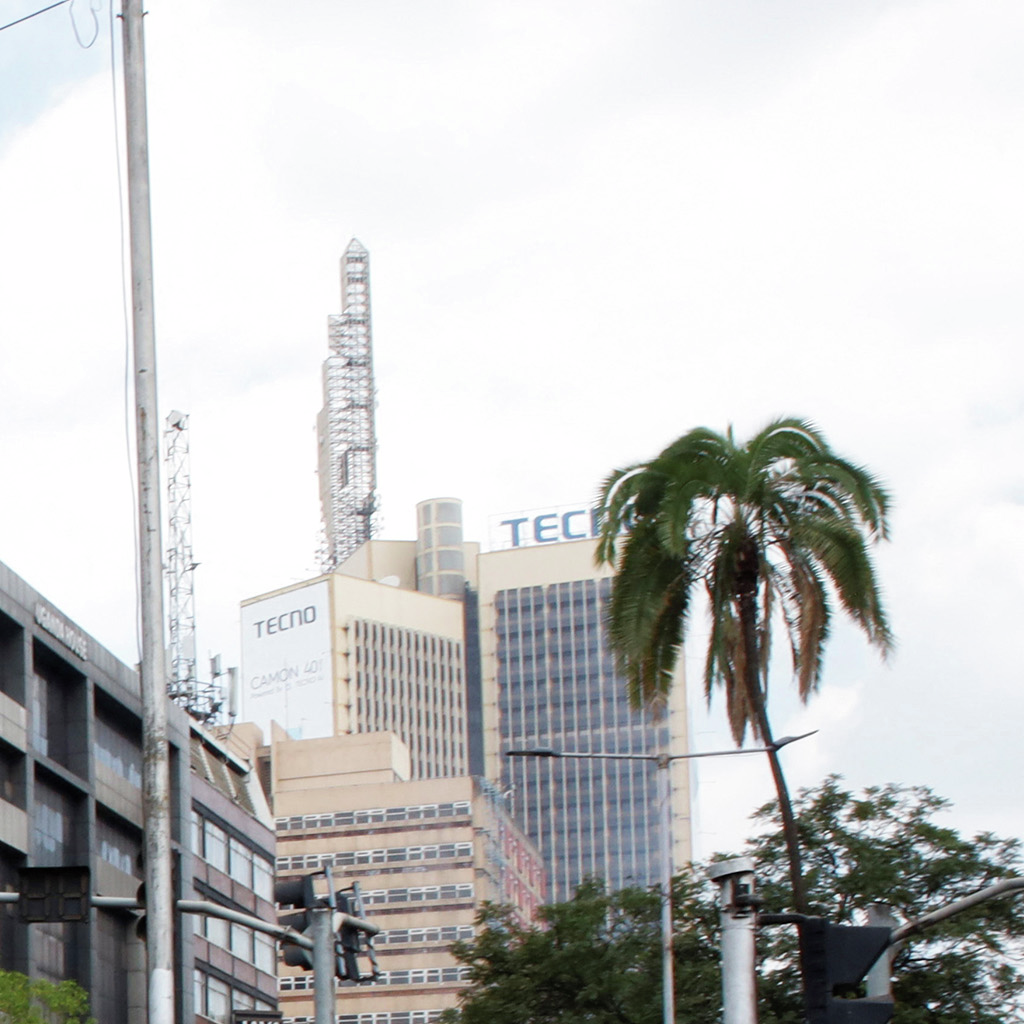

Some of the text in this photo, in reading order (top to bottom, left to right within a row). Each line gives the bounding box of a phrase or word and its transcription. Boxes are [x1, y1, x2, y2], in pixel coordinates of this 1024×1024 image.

[500, 504, 636, 547] TEC
[252, 605, 316, 638] TECNO
[250, 666, 299, 690] CAMON
